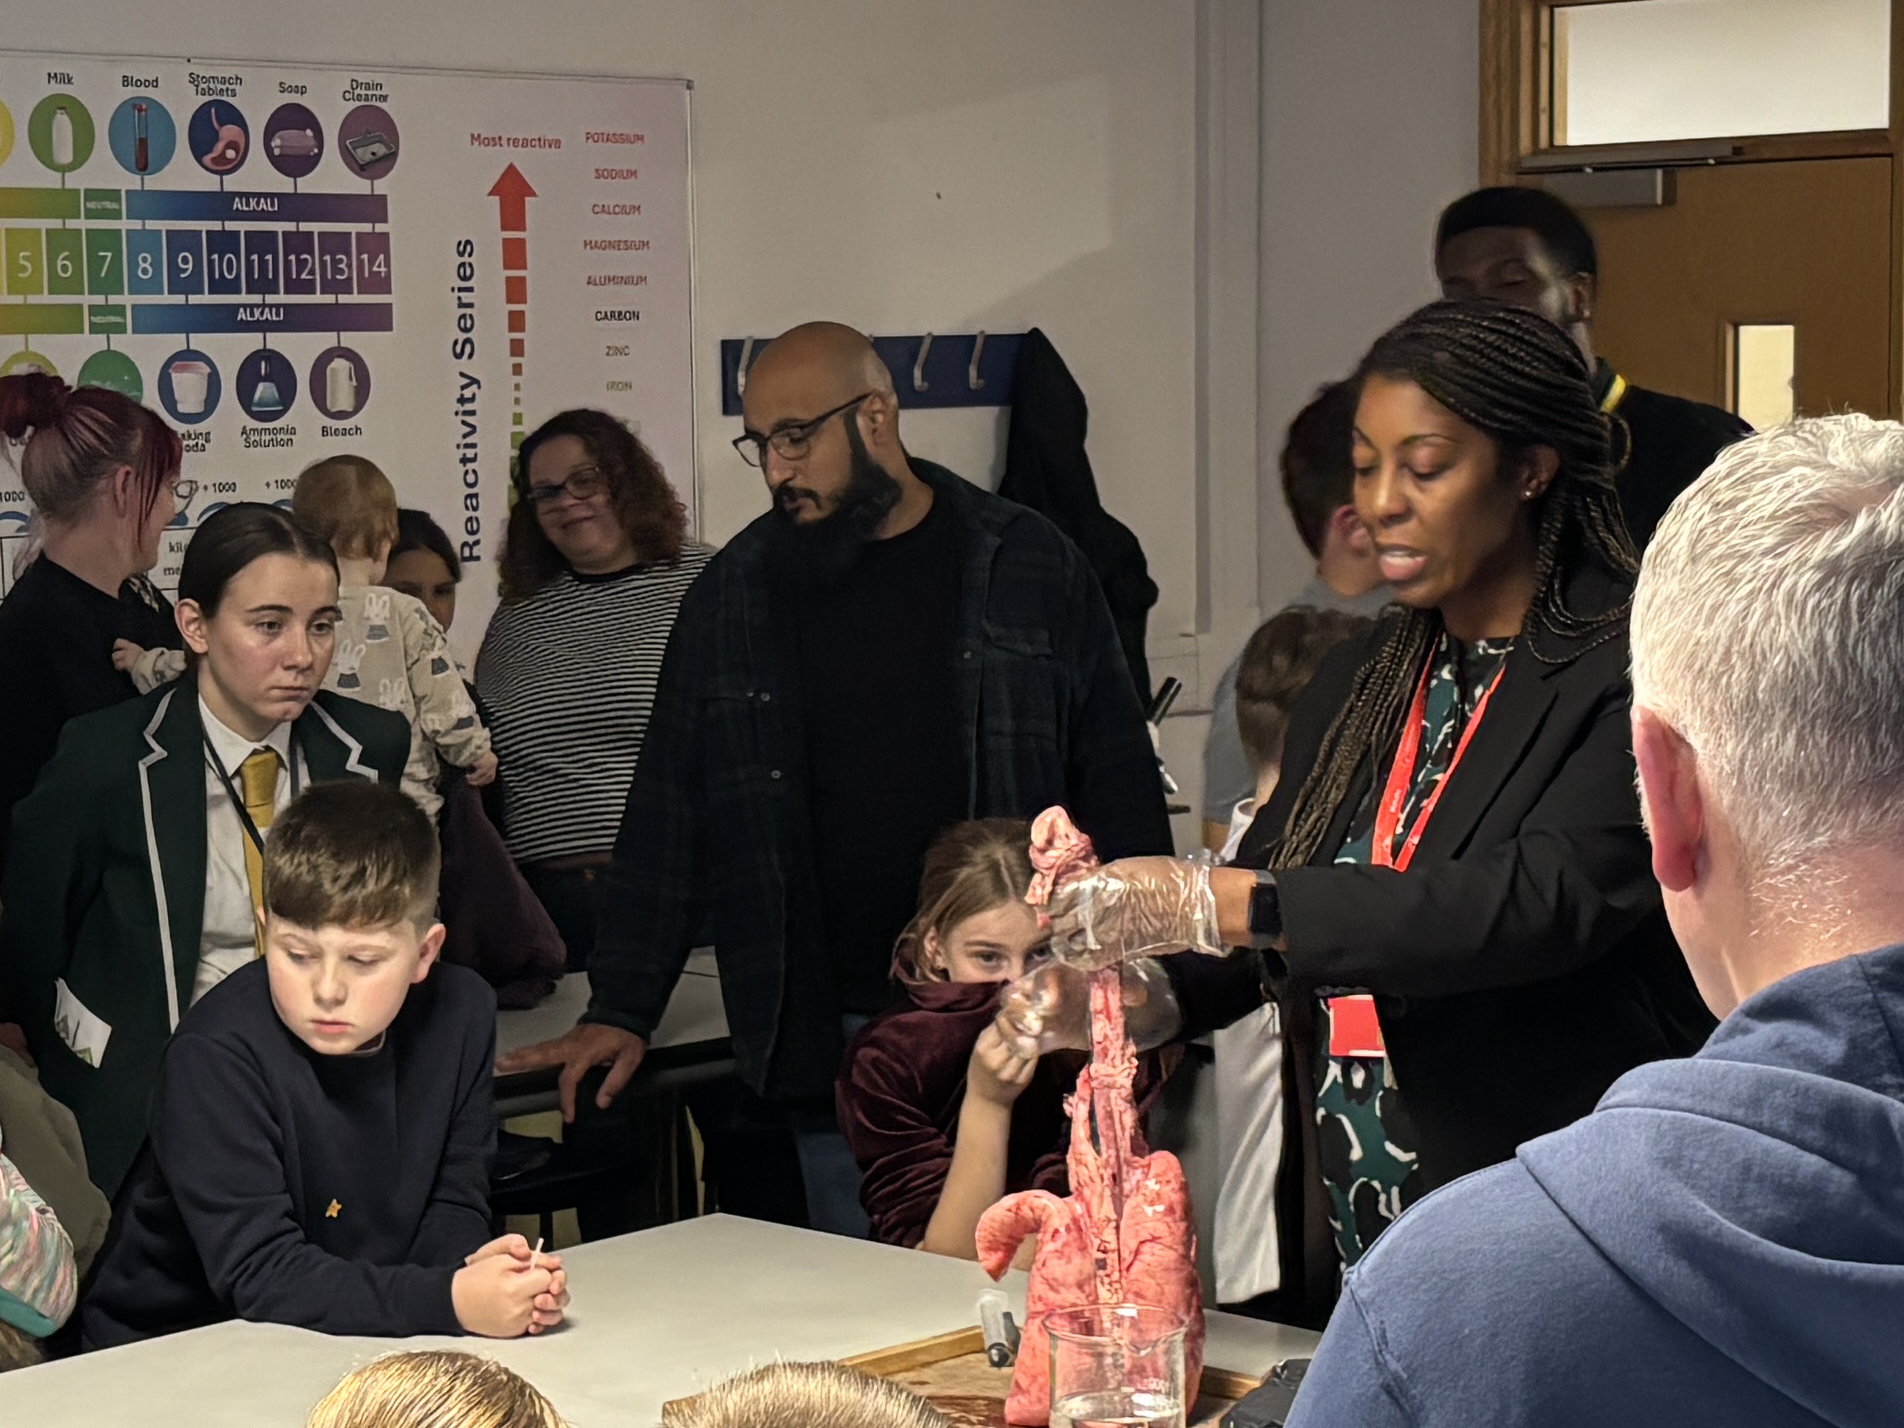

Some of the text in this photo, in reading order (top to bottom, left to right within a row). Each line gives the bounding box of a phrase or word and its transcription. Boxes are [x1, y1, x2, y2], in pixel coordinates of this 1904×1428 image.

[47, 72, 74, 86] Milk
[121, 75, 159, 89] Blood
[188, 72, 243, 86] Stomach
[350, 79, 383, 92] Drain
[194, 84, 237, 98] Tablets
[278, 82, 307, 96] Soap
[342, 90, 389, 103] Cleaner
[470, 132, 562, 149] Most reactive
[585, 132, 645, 144] POTASSIUM
[594, 168, 638, 180] SODIUM
[233, 196, 279, 212] ALKALI
[591, 204, 641, 216] CALCIUM
[583, 239, 650, 251] MAGNESIUM
[18, 251, 33, 278] 5
[56, 252, 73, 278] 6
[98, 252, 112, 277] 7
[137, 253, 153, 279] 8
[177, 252, 193, 278] 9
[210, 253, 237, 279] 10
[250, 254, 274, 279] 11
[288, 254, 314, 279] 12
[322, 254, 349, 280] 13
[360, 253, 387, 278] 14
[237, 307, 284, 321] ALKALI
[595, 310, 640, 321] CARBON
[606, 346, 630, 357] ZINC
[606, 381, 633, 392] IRON
[451, 238, 482, 563] Reactivity Series
[181, 430, 211, 443] aking
[240, 425, 297, 438] Ammonia
[321, 425, 363, 438] Bleach
[184, 443, 206, 453] oda
[243, 437, 294, 449] Solution
[212, 481, 237, 494] 1000
